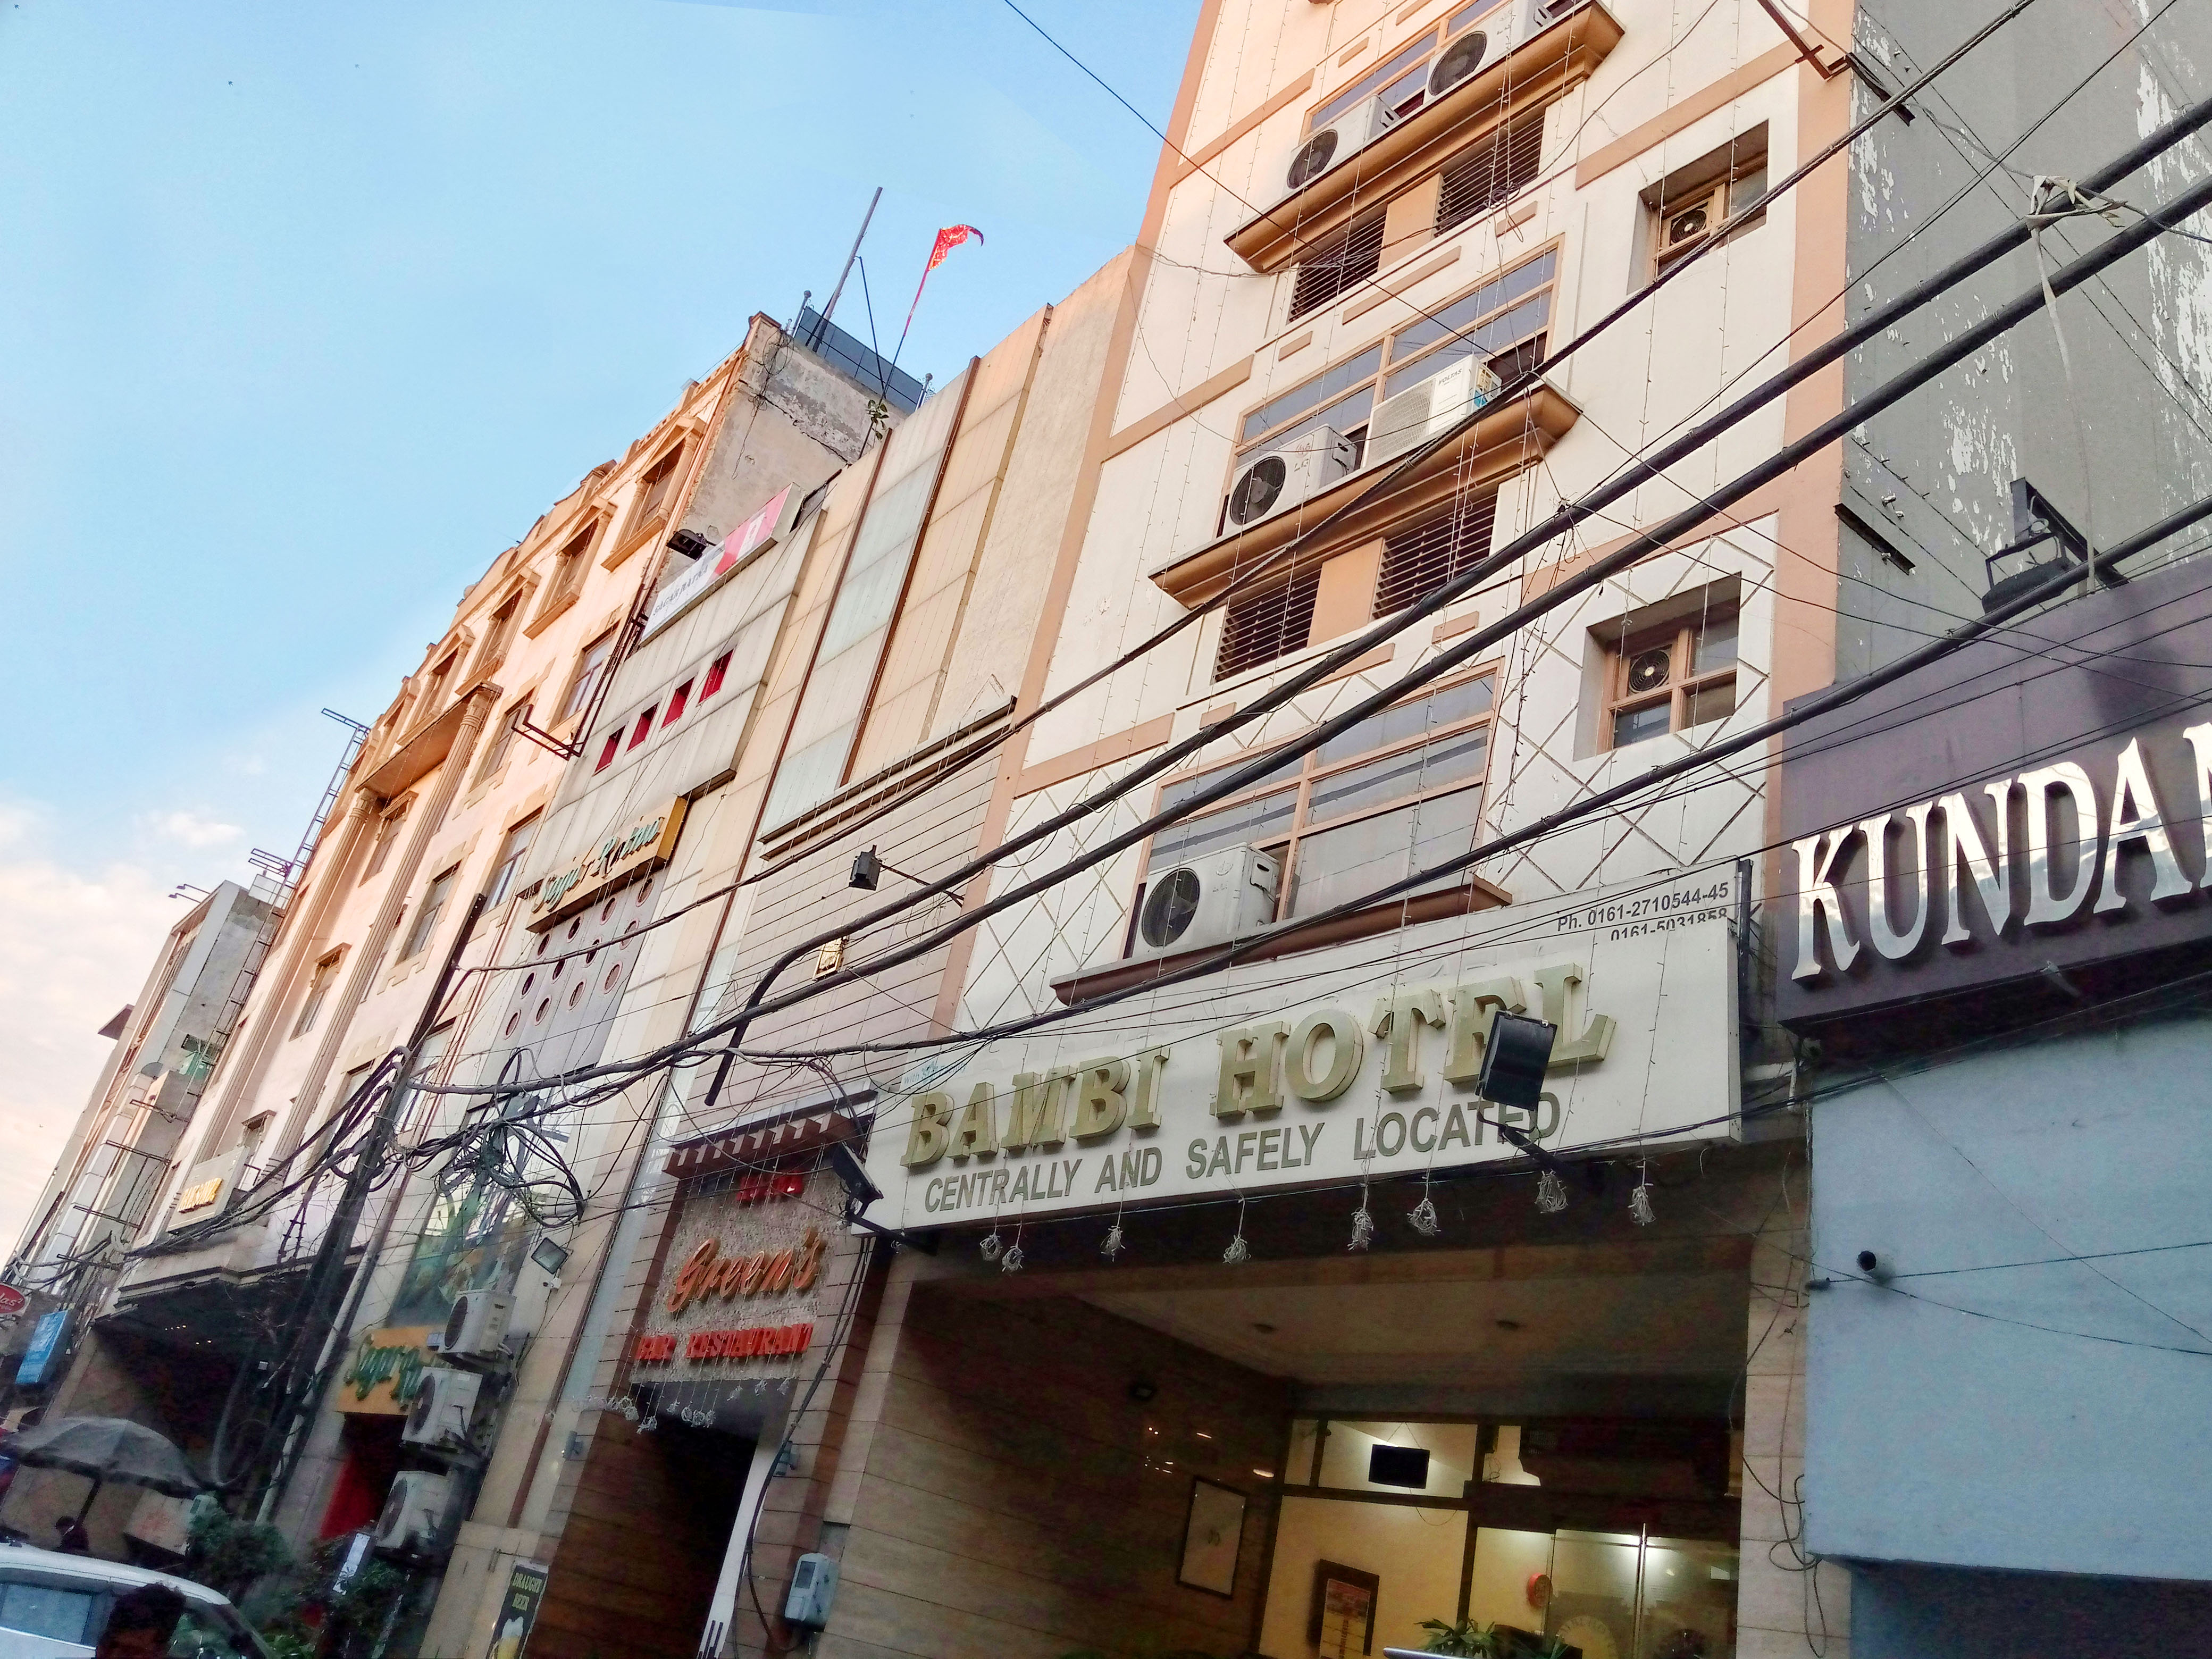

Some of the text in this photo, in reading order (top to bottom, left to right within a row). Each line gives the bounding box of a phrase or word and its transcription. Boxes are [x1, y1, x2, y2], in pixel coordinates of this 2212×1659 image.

[1438, 368, 1462, 386] VOLTAS
[1557, 882, 1729, 932] Ph. 0161-2710544-45
[900, 963, 1616, 1168] BAMBI HOTEL
[925, 1092, 1561, 1213] CENTRALLY AND SAFELY LOCATED
[685, 1322, 815, 1359] RESTAURANT
